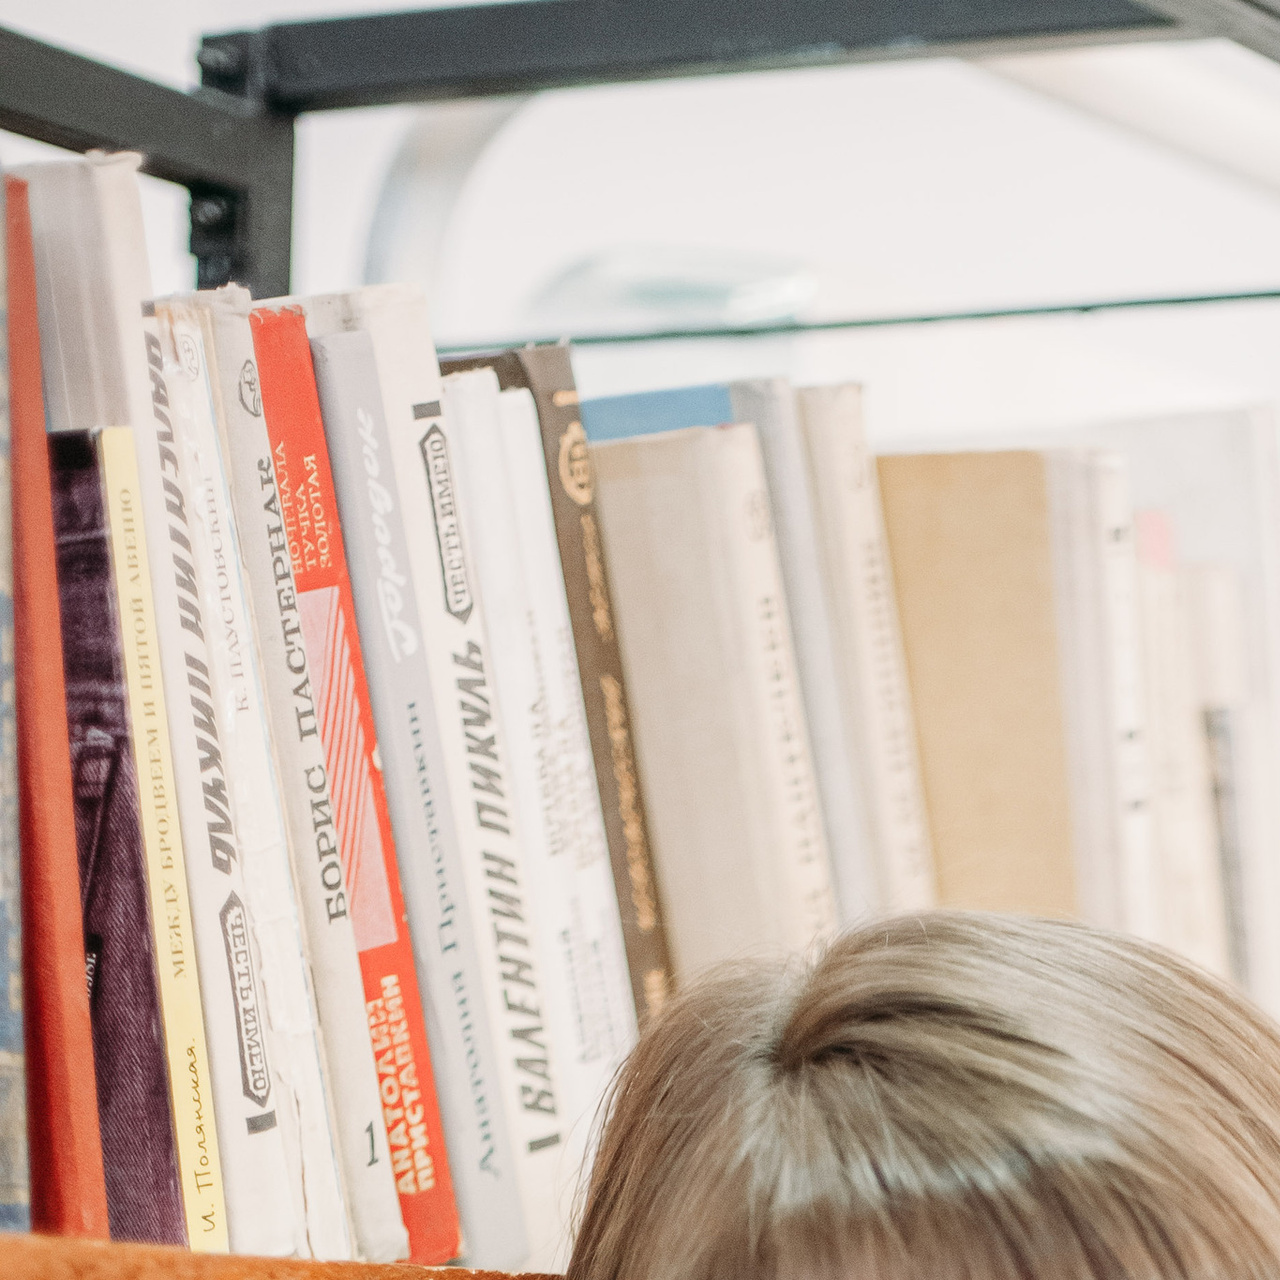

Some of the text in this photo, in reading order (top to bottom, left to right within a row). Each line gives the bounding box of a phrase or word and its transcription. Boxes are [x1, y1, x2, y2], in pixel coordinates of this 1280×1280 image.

[275, 440, 304, 575] НОЧЕВАЛА
[296, 482, 317, 572] ТУЧКА
[303, 453, 332, 569] ЗОЛОТАЯ
[356, 407, 419, 665] Городок
[429, 438, 467, 606] ЧЕСТЬ ИМЕЮ
[119, 488, 186, 979] МЕЖДУ БРОДВЕЕМ И ПЯТОЙ АВЕНЮ
[184, 650, 239, 876] ПИКУЛЬ
[257, 456, 348, 925] БОРИС ПАСТЕРНАК
[407, 702, 457, 954] Приставкин
[452, 640, 557, 1116] ВАЛЕНТИН ПИКУЛЬ
[230, 913, 267, 1097] ЧЕСТЬ ИМЕЮ
[379, 973, 435, 1194] ПРИСТАВКИН
[365, 1121, 379, 1167] 1
